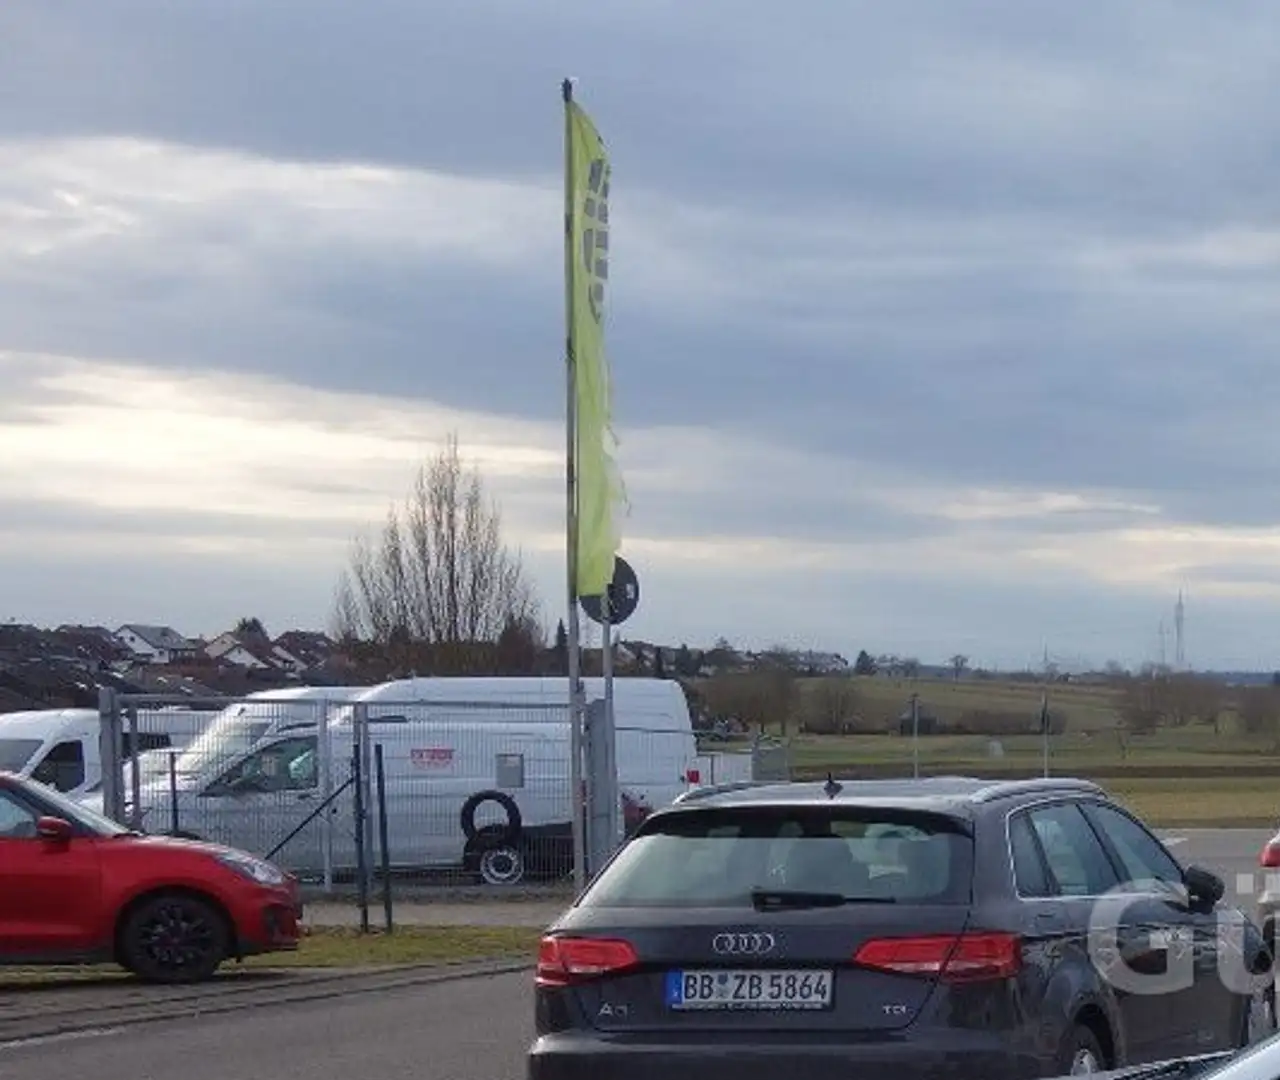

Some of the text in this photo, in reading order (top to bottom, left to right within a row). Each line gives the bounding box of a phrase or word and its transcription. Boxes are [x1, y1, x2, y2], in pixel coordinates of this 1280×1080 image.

[684, 974, 827, 1000] BB ZB 5864
